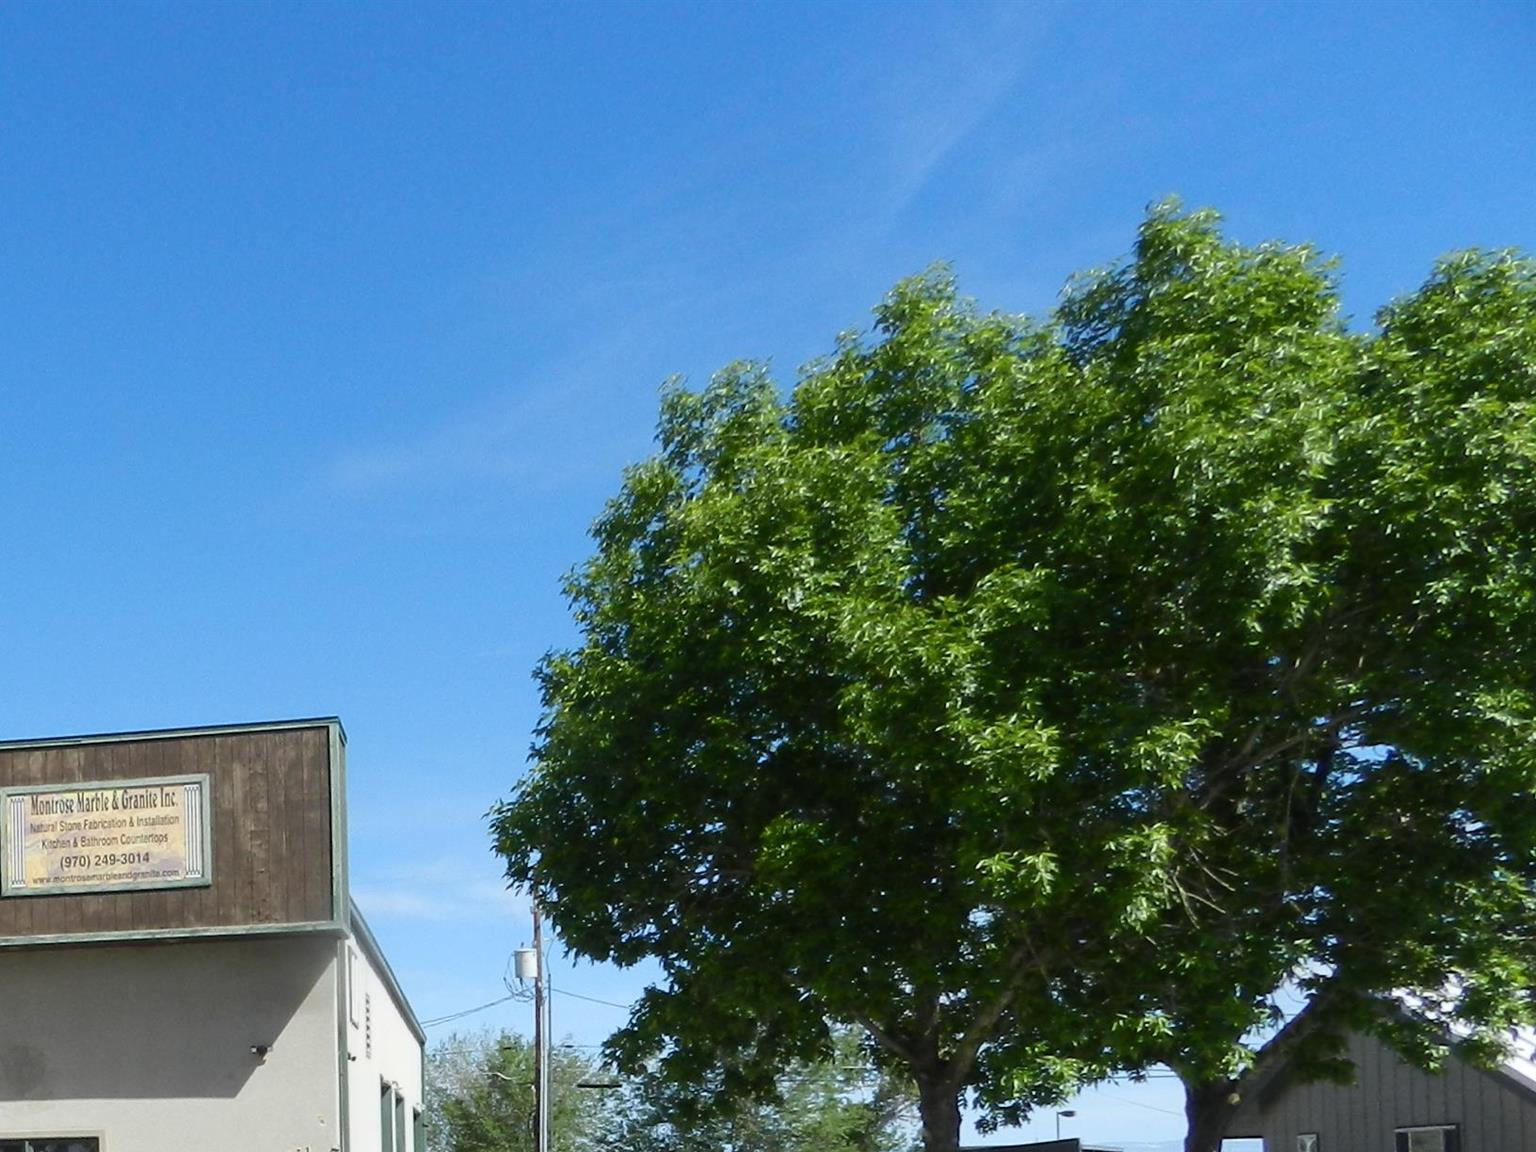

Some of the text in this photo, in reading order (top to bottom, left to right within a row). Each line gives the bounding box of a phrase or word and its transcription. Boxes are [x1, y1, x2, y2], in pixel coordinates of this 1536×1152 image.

[30, 786, 179, 816] Montrose Marble & Granite Inc.
[30, 814, 180, 833] Natural Stone Fabrication & Installation
[41, 833, 169, 850] Kitchen & Bathroom Countertops
[60, 851, 150, 871] (970) 249-3014
